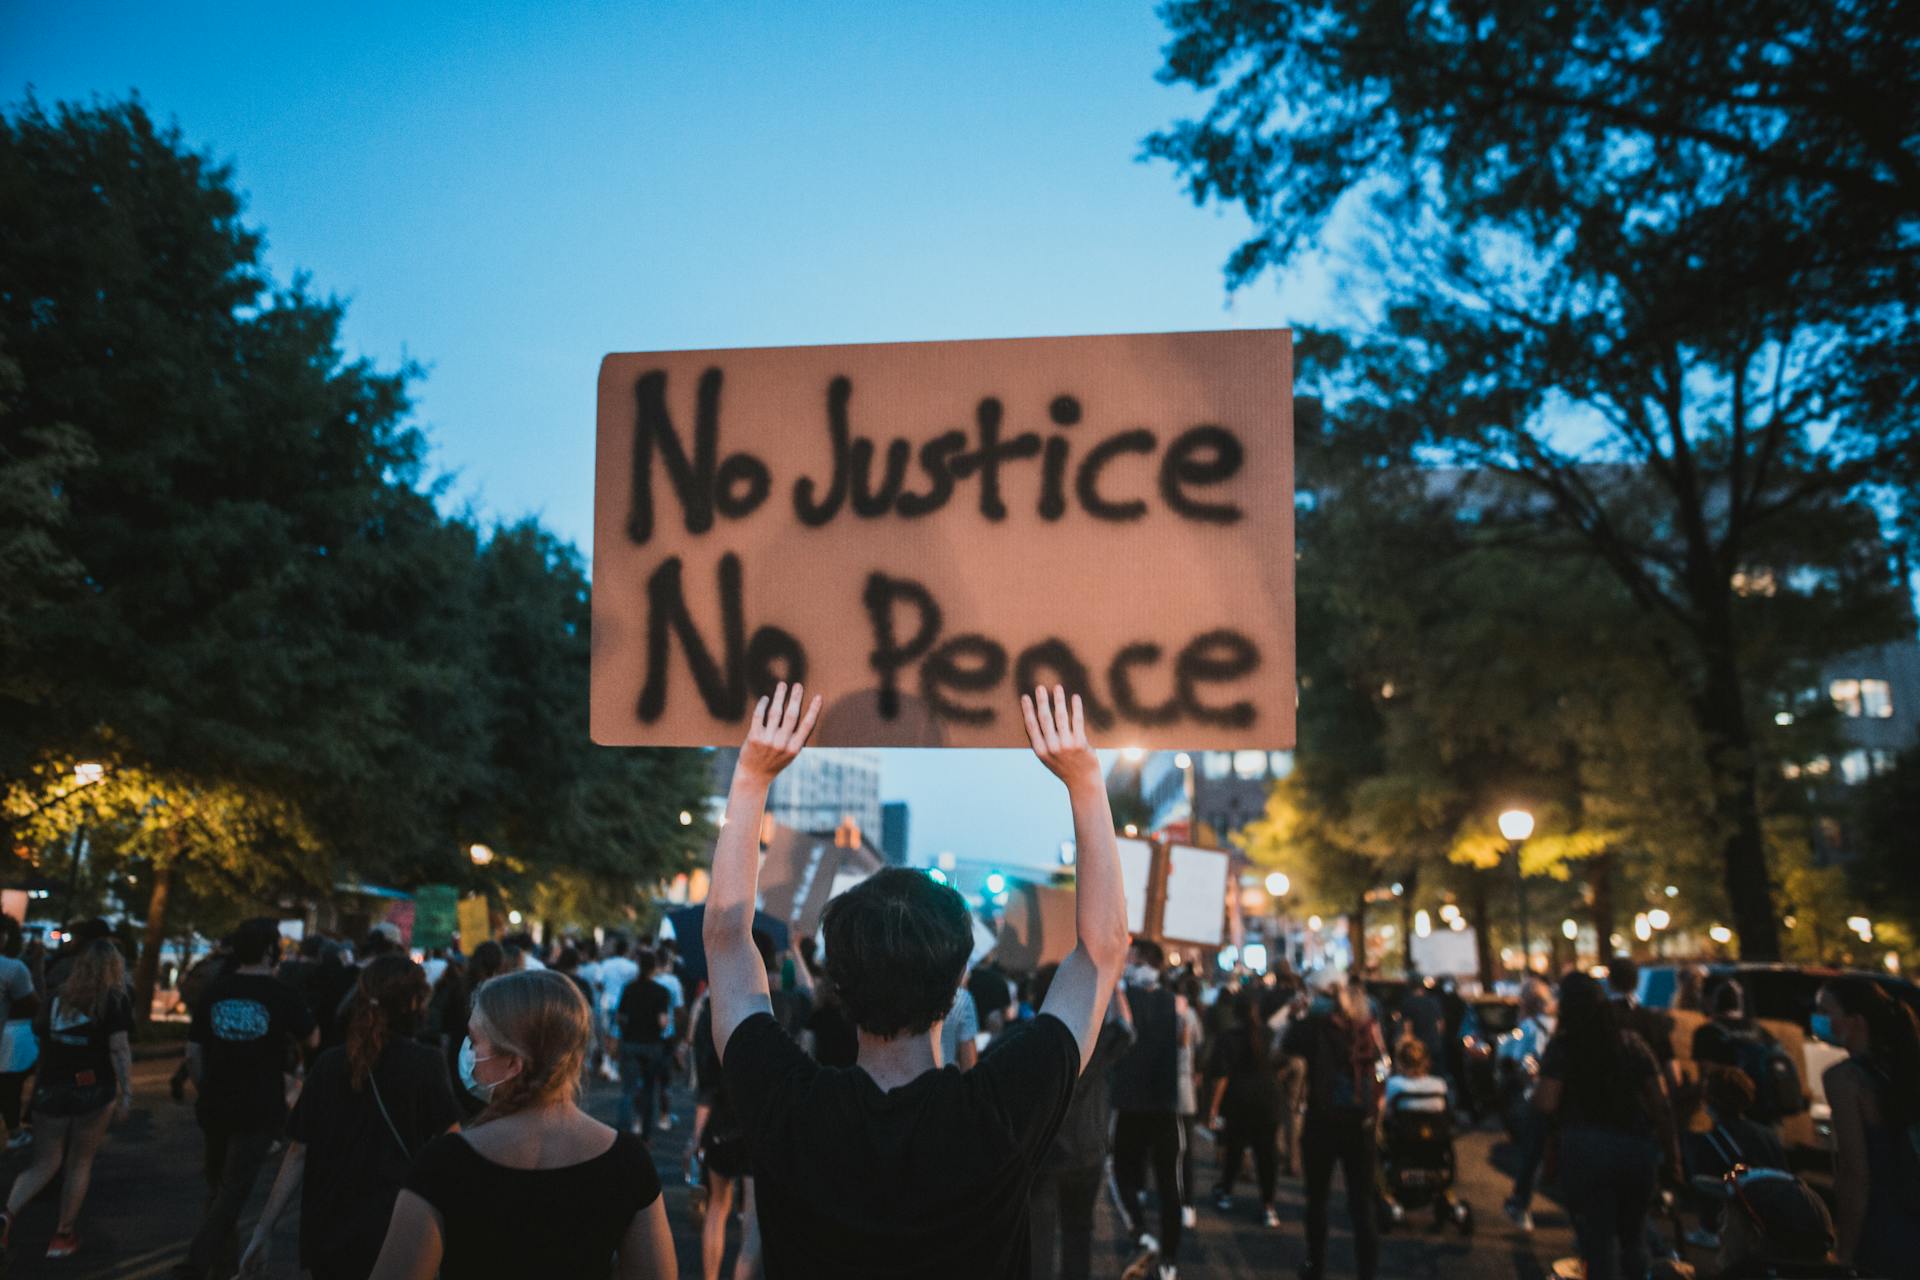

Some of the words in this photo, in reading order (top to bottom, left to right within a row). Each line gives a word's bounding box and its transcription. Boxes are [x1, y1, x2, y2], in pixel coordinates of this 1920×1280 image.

[625, 366, 772, 546] No
[793, 375, 1245, 527] Justice
[636, 553, 808, 728] No
[863, 572, 1260, 729] Peace
